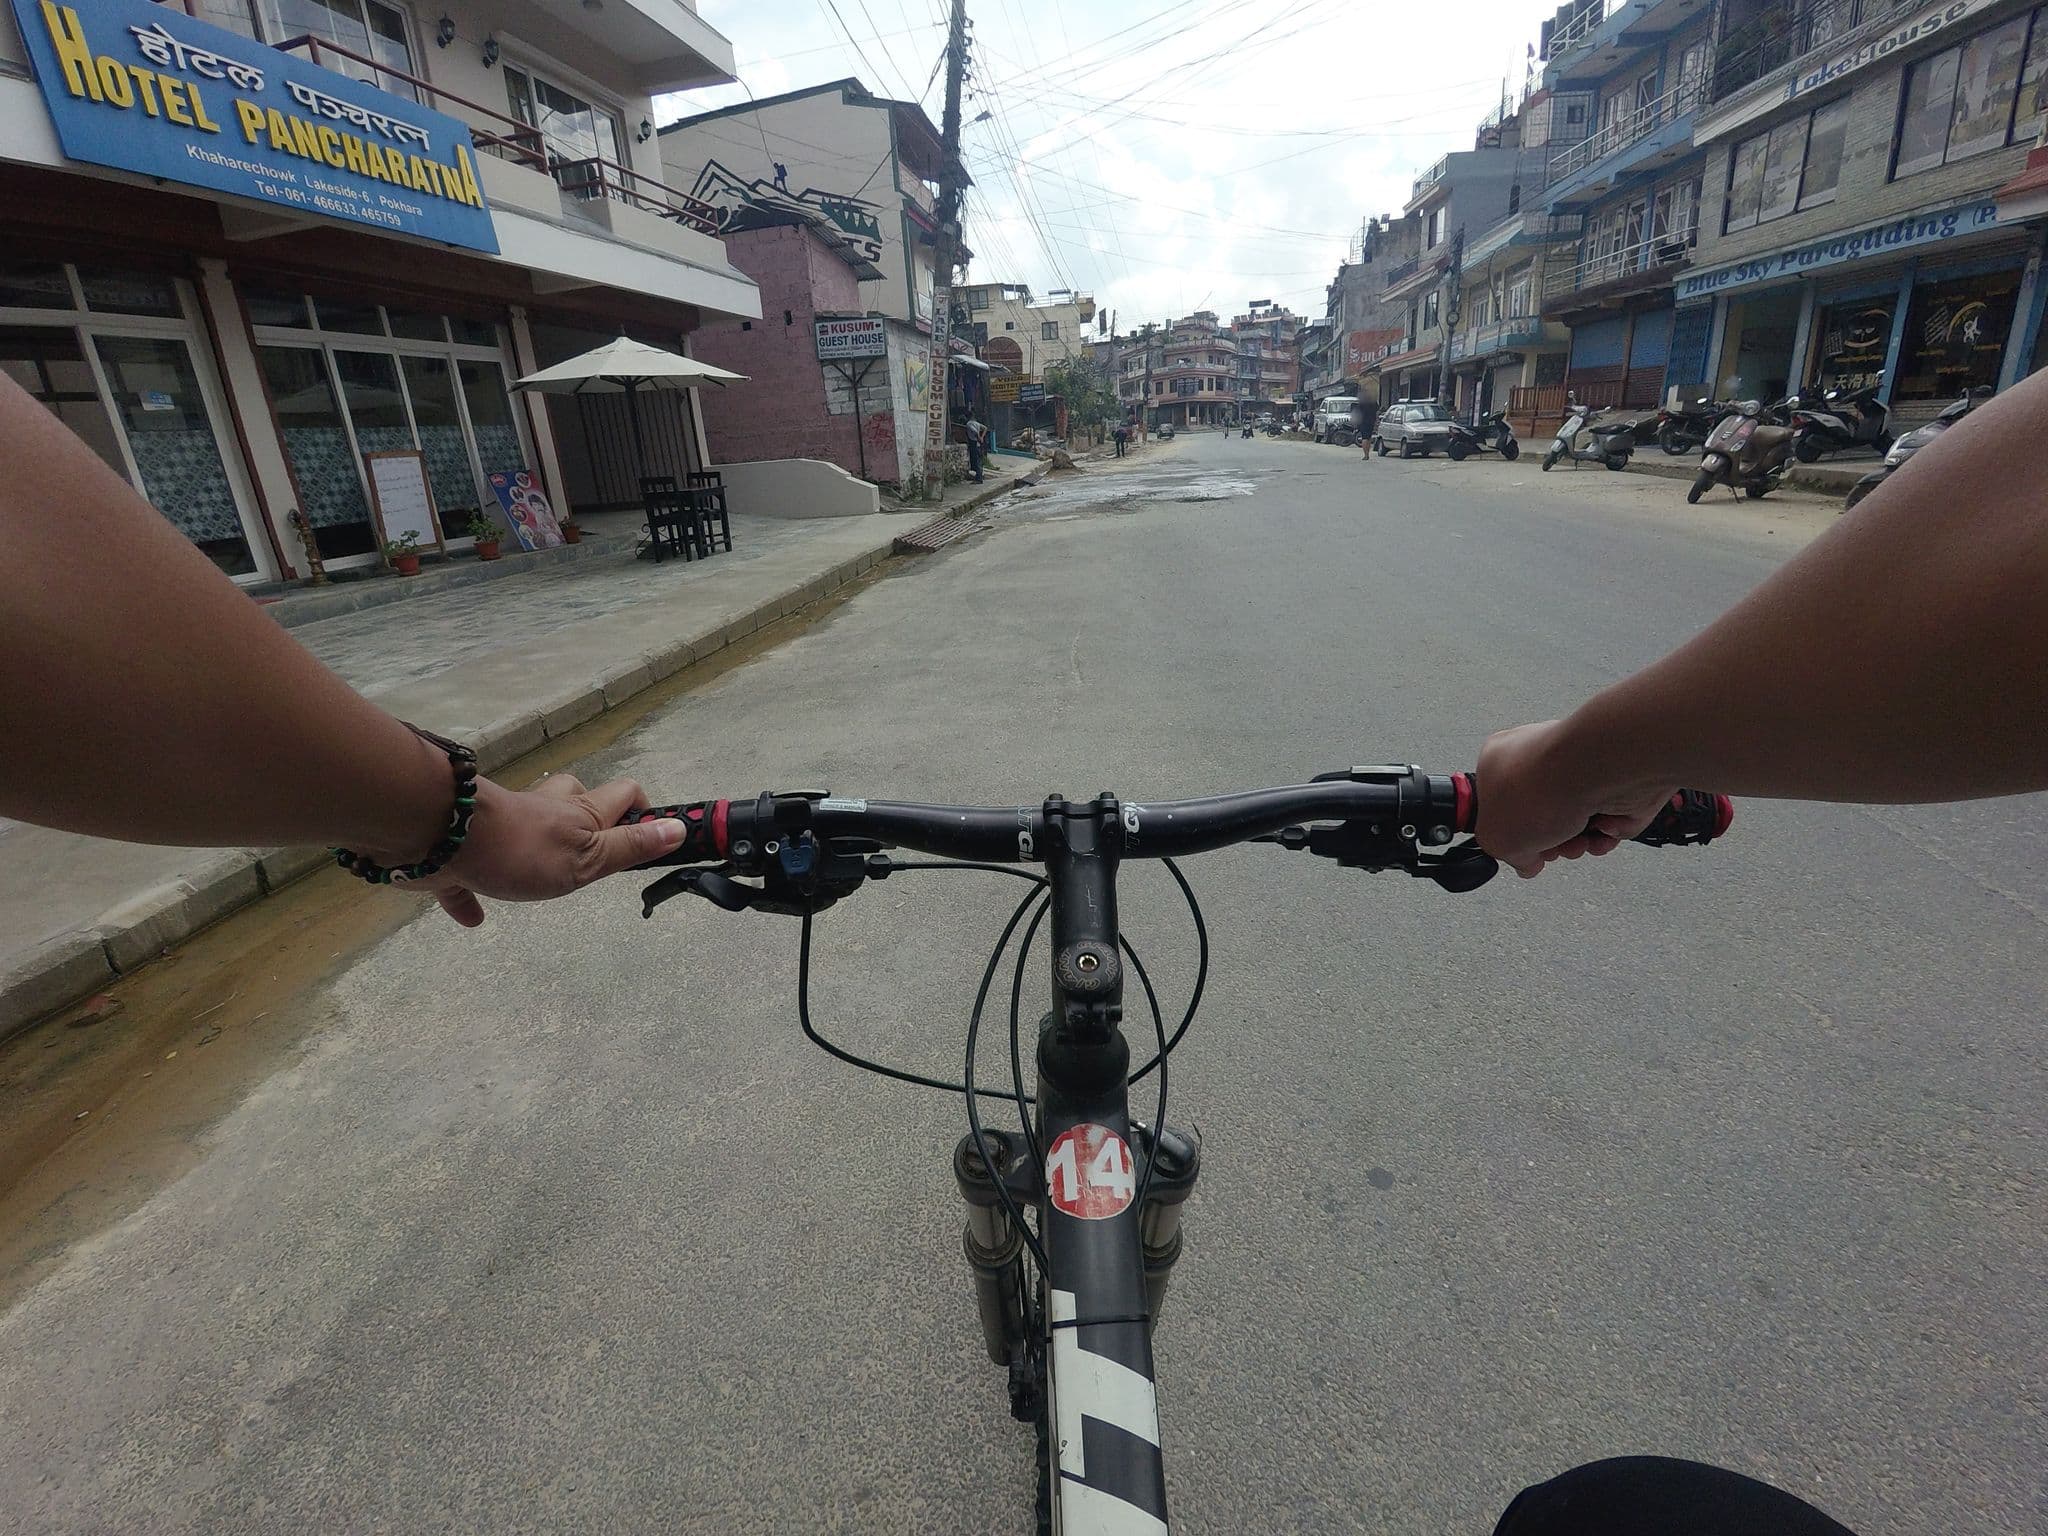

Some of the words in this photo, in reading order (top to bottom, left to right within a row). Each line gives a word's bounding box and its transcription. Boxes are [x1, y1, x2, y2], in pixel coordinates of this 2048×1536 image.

[128, 22, 266, 93] होटल
[40, 0, 221, 134] HOTEL
[235, 98, 484, 209] PANCHARATNA
[186, 143, 297, 183] Khaharechowk
[379, 195, 423, 217] Pokhara
[1685, 273, 1730, 294] Blue
[1734, 262, 1774, 286] Sky
[1778, 212, 1960, 272] Paragliding
[818, 335, 849, 347] GUEST
[851, 333, 884, 345] HOUSE
[830, 321, 875, 334] KUSUM
[930, 360, 945, 400] KUSUM
[928, 404, 942, 445] GUEST
[1049, 1137, 1132, 1201] 14
